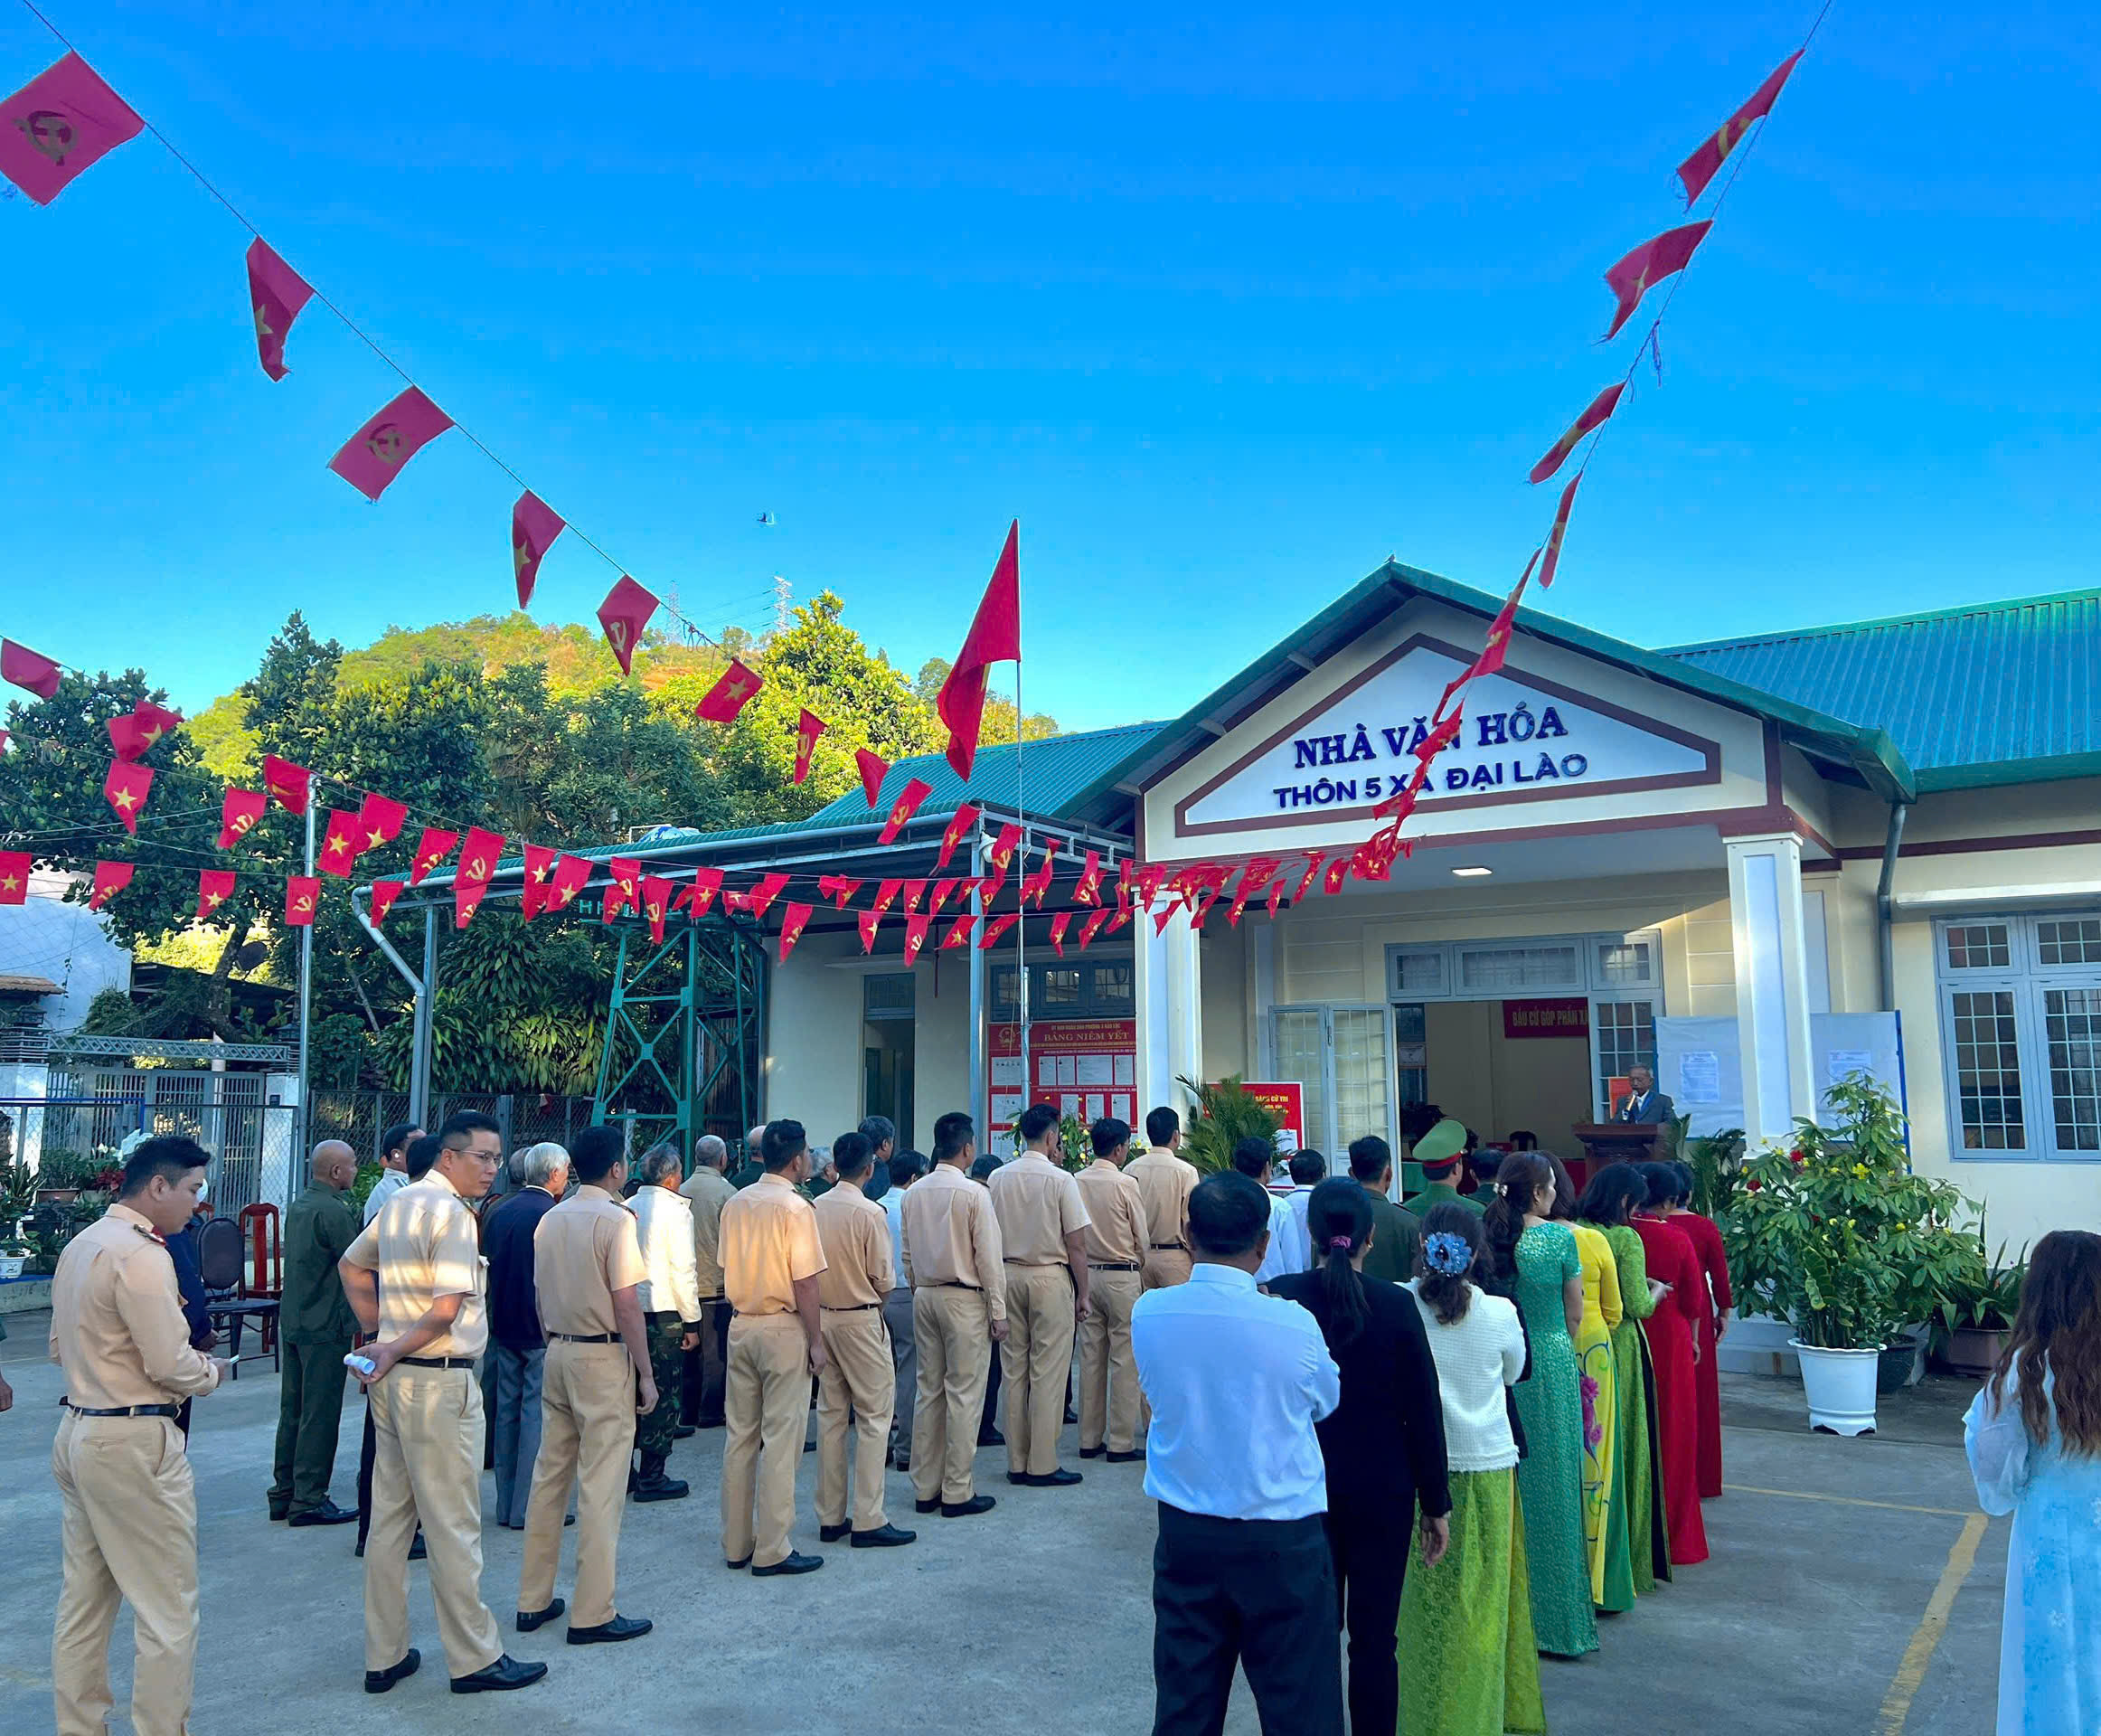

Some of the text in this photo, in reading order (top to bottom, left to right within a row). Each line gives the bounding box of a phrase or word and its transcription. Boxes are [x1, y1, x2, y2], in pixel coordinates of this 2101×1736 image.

[1294, 722, 1377, 769] NHÀ
[1476, 701, 1569, 746] HÓA
[1273, 778, 1358, 808] THÔN
[1364, 776, 1381, 799] 5
[1446, 762, 1503, 791] ĐẠI
[1513, 752, 1588, 783] LÀO
[1044, 1029, 1130, 1042] BẢNG NIÊM YẾT
